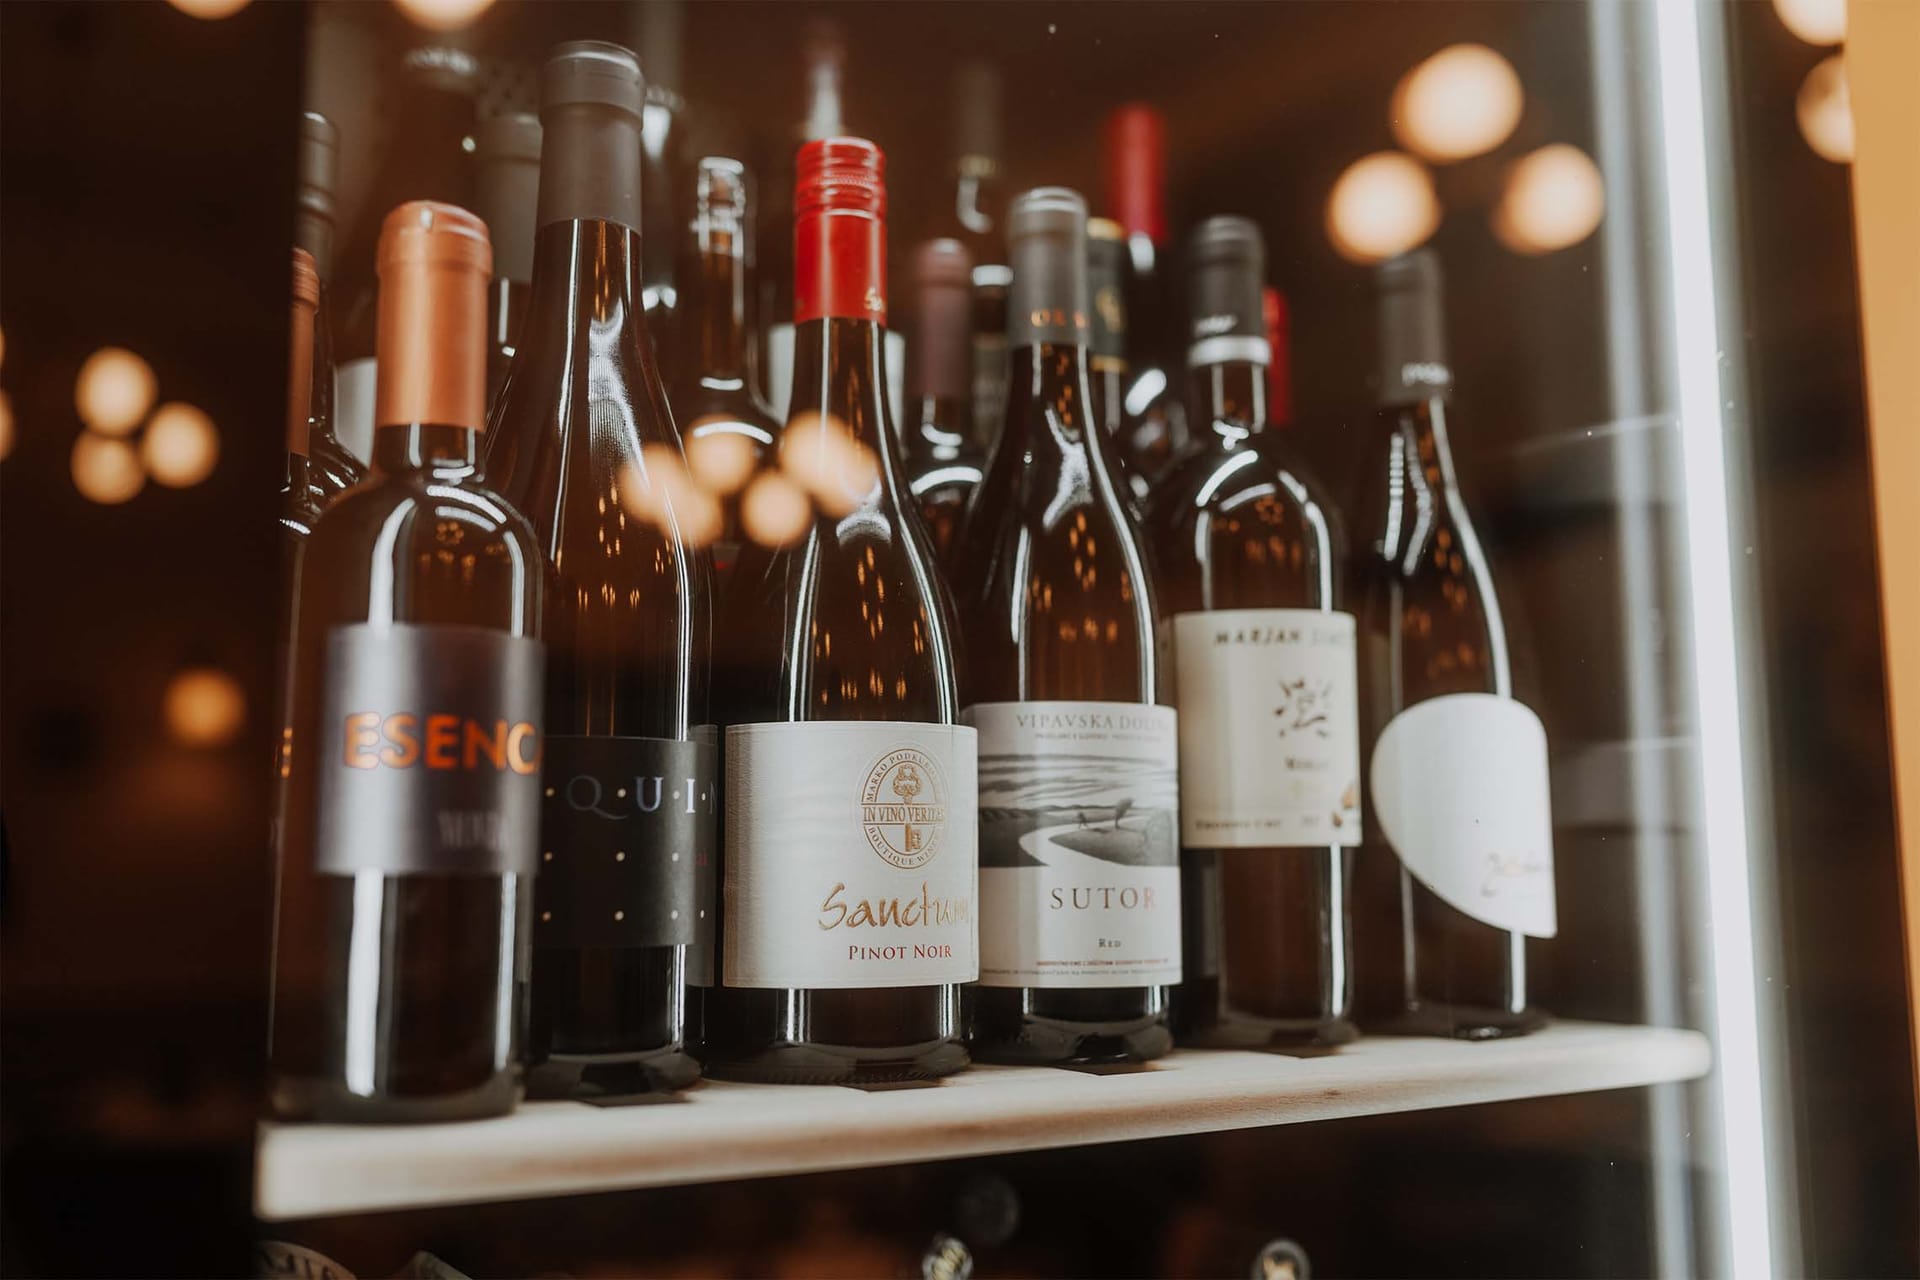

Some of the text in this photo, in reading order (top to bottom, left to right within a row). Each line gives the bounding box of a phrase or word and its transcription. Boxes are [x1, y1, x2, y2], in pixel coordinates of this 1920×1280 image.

[1016, 714, 1113, 730] VIPAVSKA
[866, 762, 888, 802] MARKO
[863, 806, 876, 822] IN
[878, 806, 906, 822] VINO
[868, 826, 915, 866] BOUTIQUE
[1050, 886, 1157, 910] SUTOR
[848, 943, 952, 960] PINOT NOIR
